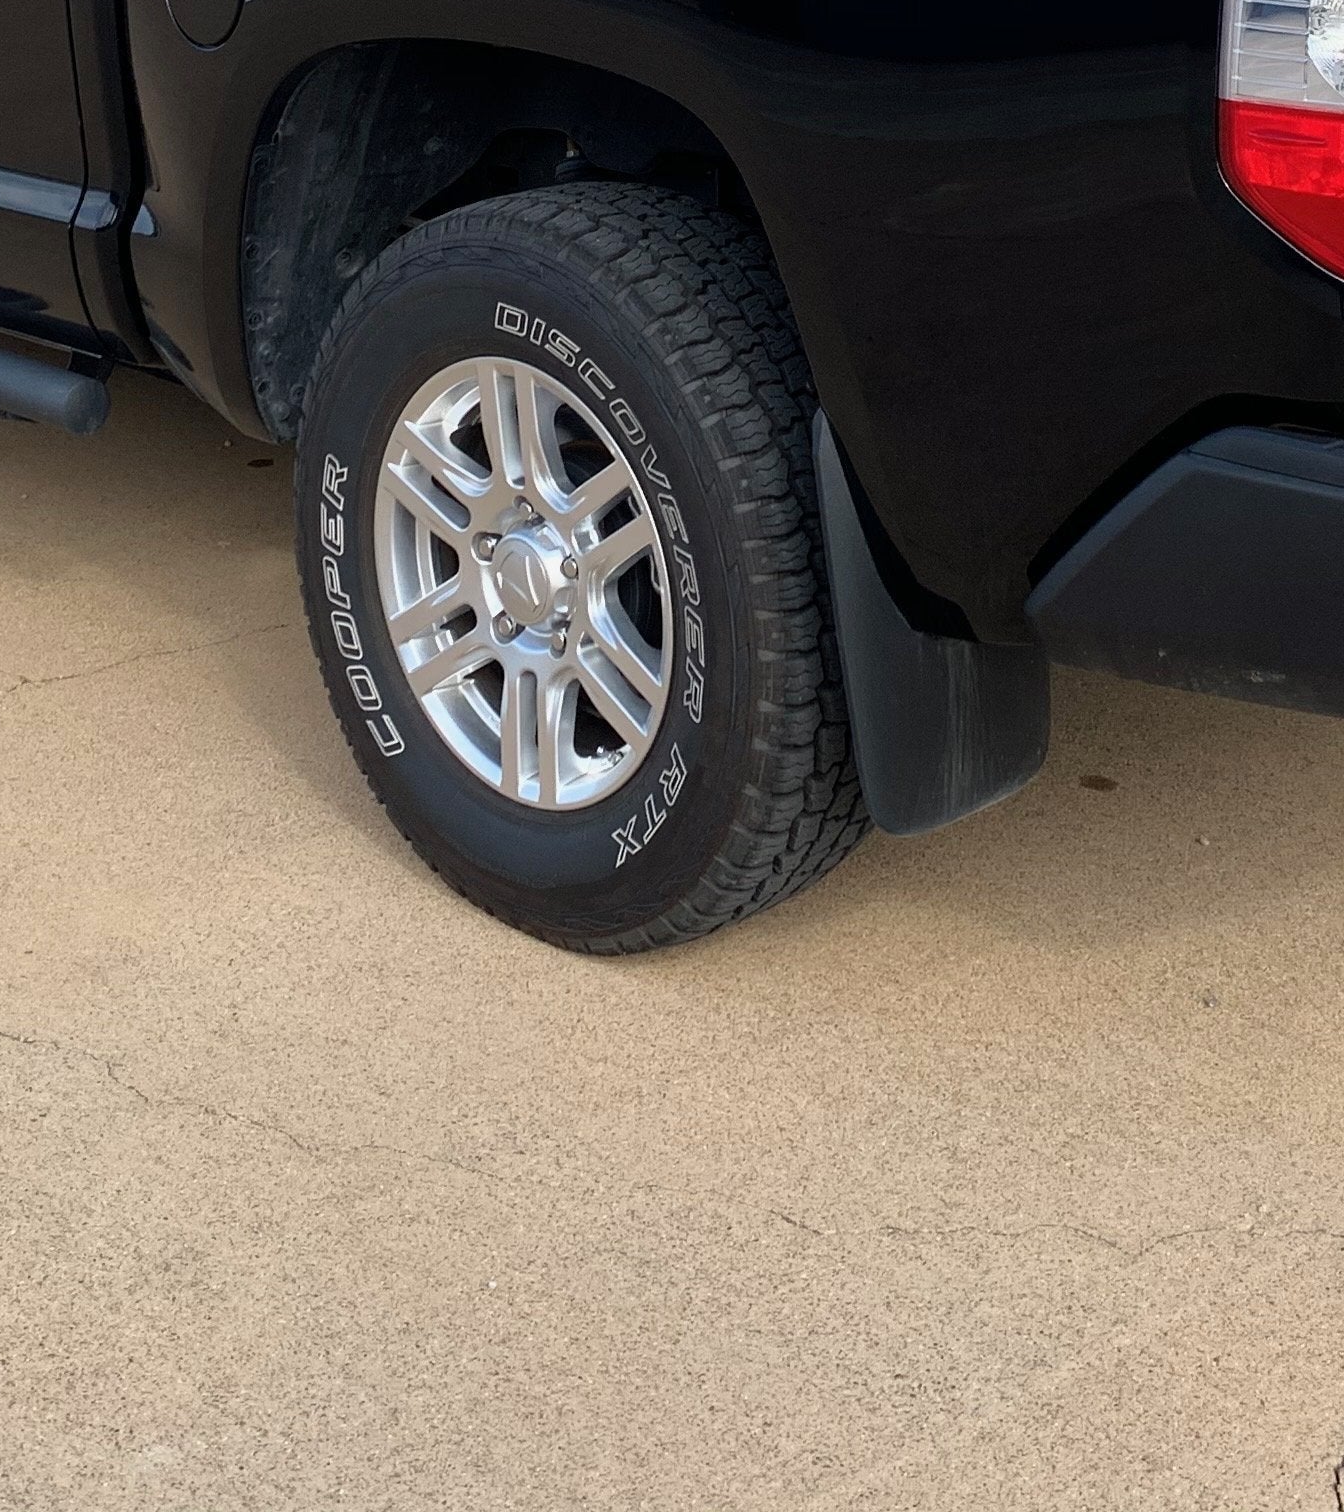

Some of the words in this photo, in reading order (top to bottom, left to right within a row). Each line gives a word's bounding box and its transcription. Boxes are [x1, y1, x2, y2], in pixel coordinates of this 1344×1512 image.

[320, 452, 405, 757] COOPER
[494, 302, 706, 724] DISCOVERER
[611, 742, 688, 868] RTX
